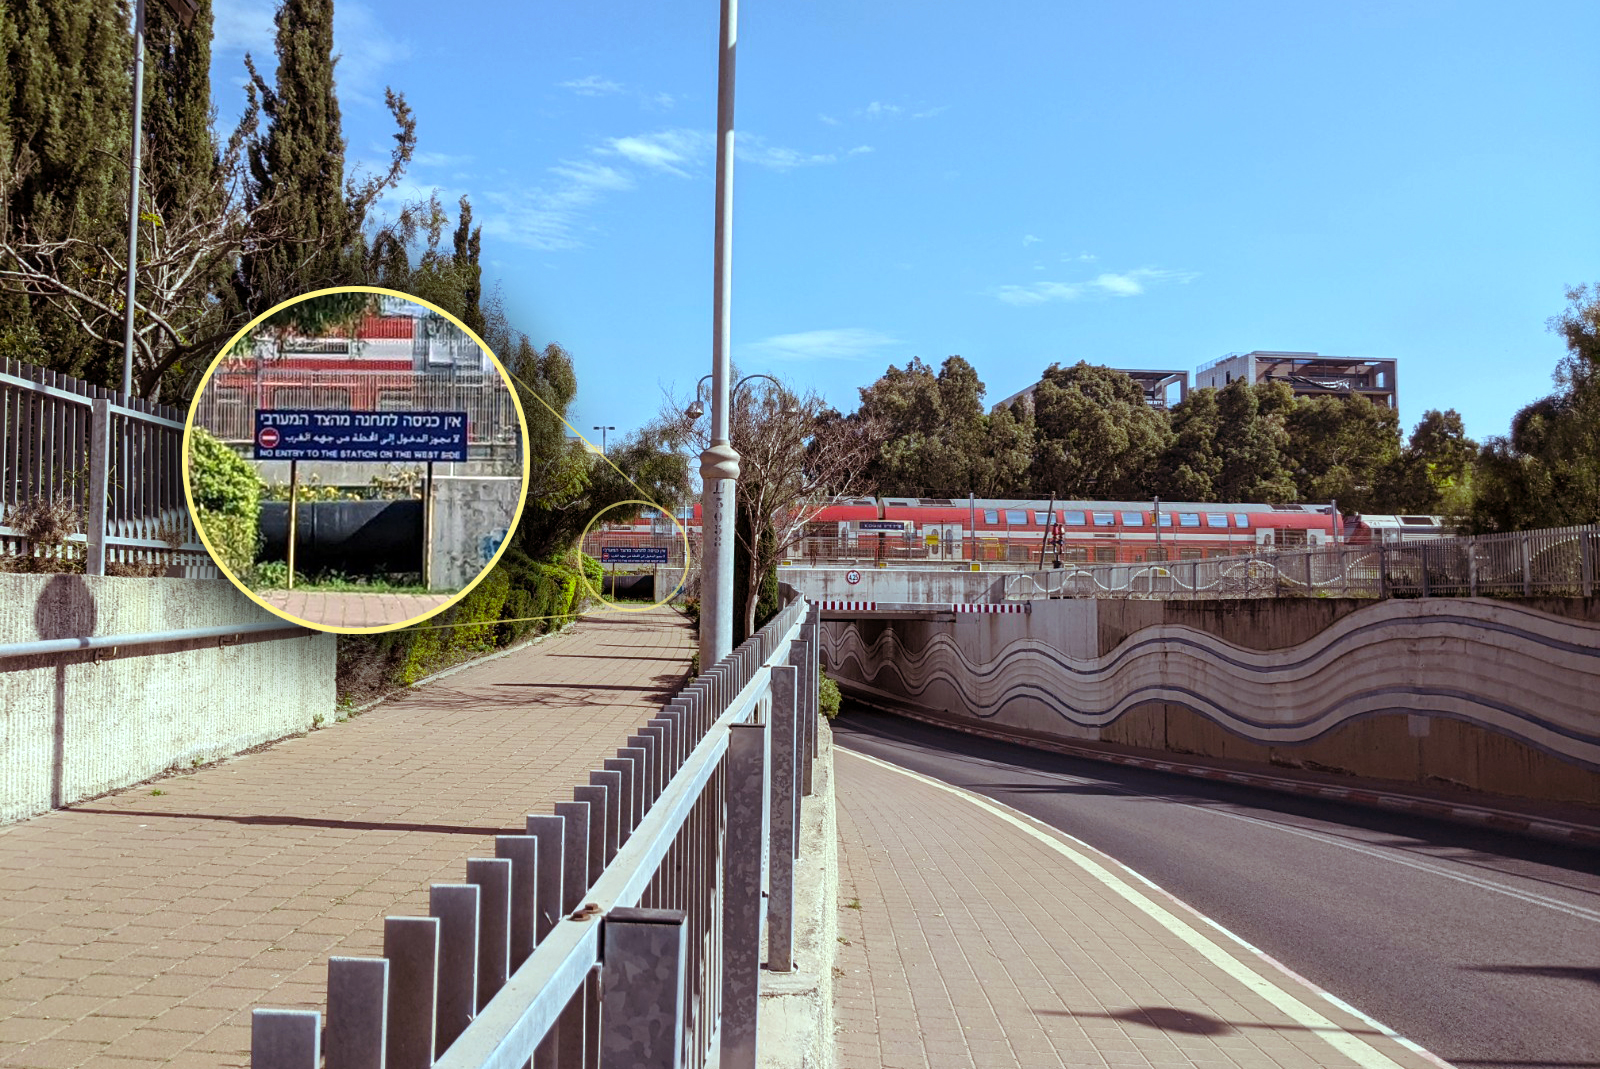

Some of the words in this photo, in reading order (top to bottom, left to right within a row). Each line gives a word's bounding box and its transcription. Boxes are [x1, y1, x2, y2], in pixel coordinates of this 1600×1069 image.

[260, 413, 310, 426] המערבי
[313, 414, 351, 427] מהצד
[355, 413, 398, 427] לתחנה
[403, 415, 440, 427] כניסה
[444, 416, 462, 430] אין
[259, 449, 274, 457] NO
[275, 449, 305, 457] ENTRY
[306, 449, 320, 457] TO
[321, 449, 338, 458] THE
[340, 449, 378, 459] STATION
[380, 449, 393, 459] ON
[394, 450, 412, 459] THE
[413, 450, 439, 459] WEST
